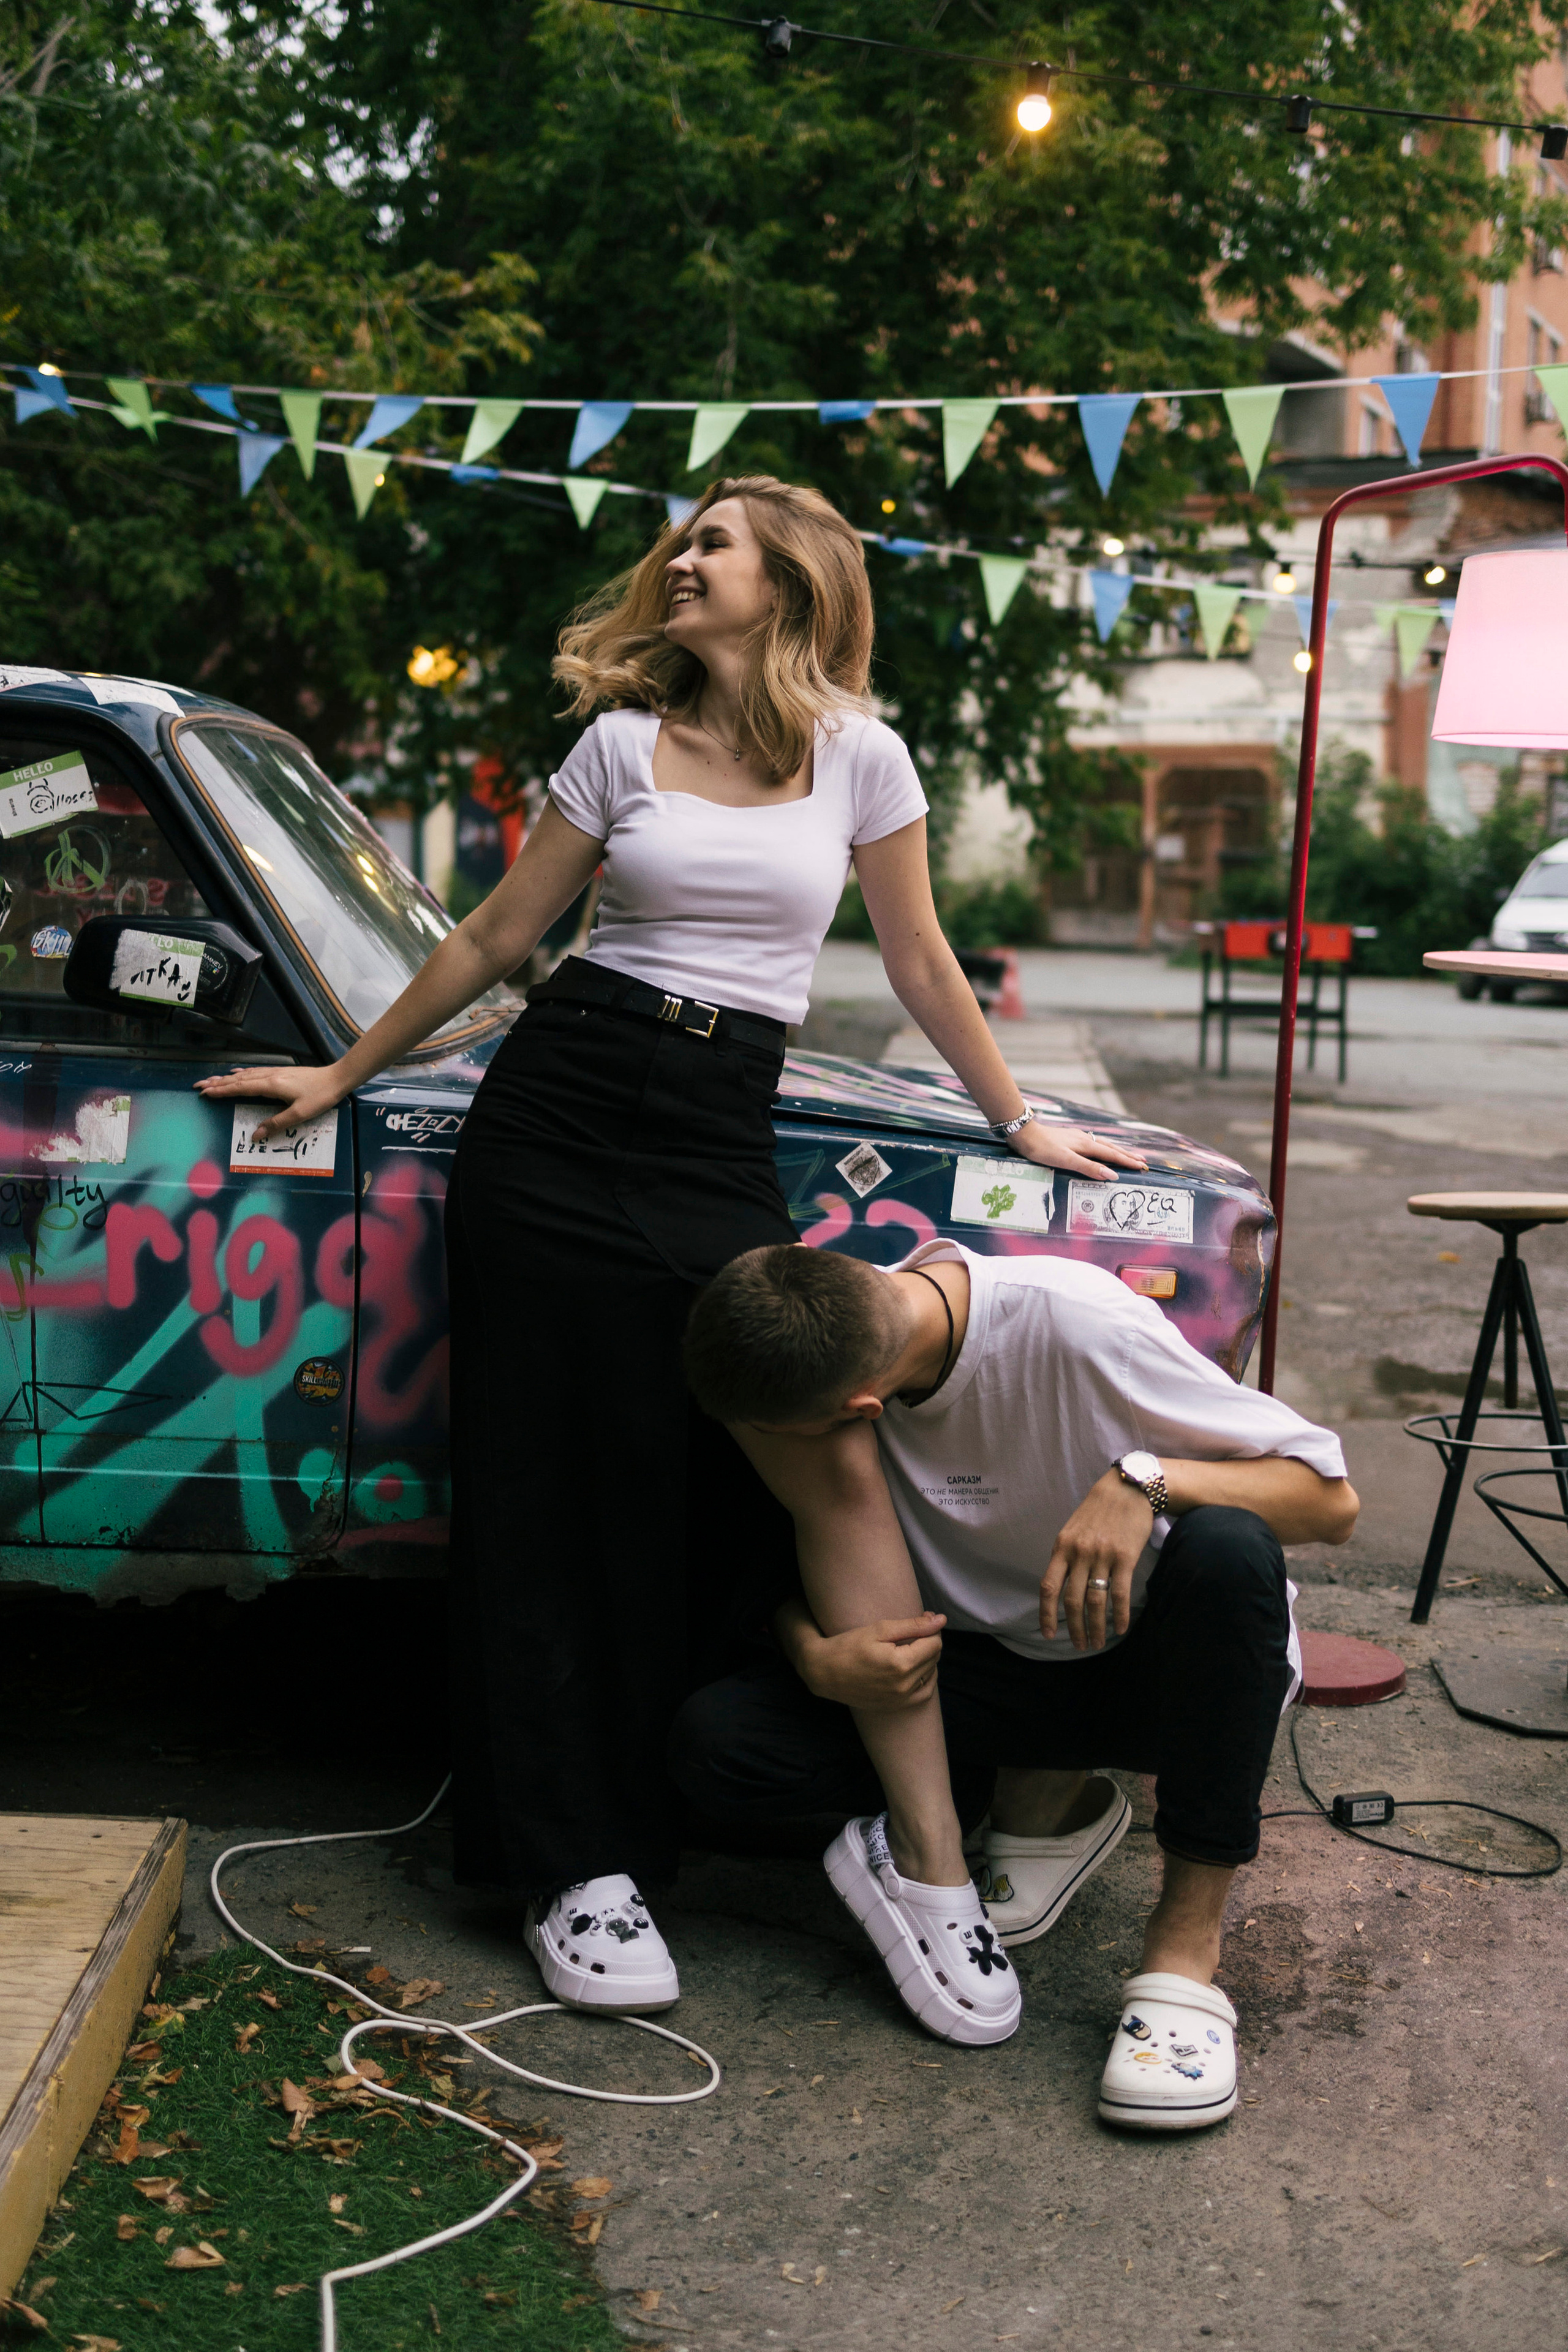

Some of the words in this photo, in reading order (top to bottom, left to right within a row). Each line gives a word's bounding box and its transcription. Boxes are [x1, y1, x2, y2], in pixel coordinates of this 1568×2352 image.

[13, 761, 53, 782] HELLO
[0, 1174, 110, 1230] guilty
[947, 1476, 981, 1484] САРКАЗМ
[870, 1853, 889, 1863] NICE
